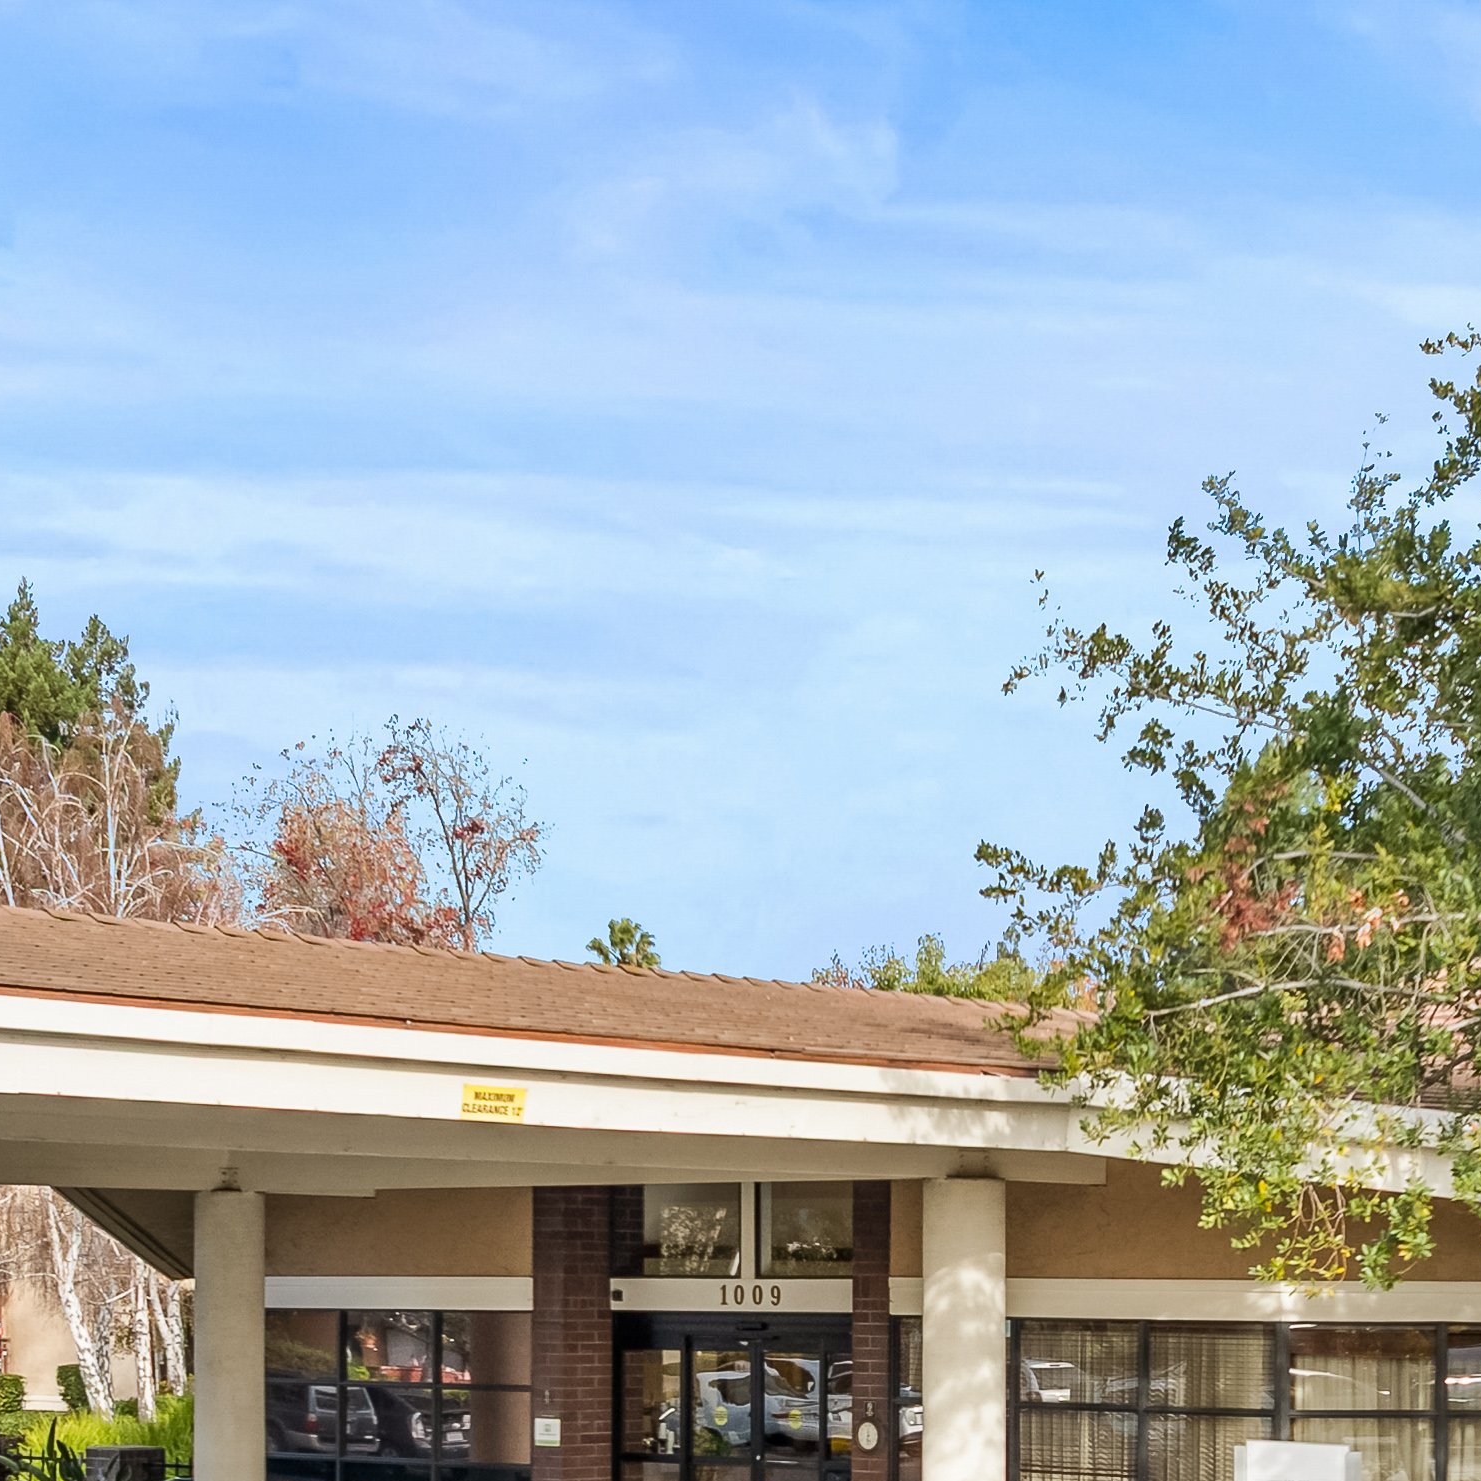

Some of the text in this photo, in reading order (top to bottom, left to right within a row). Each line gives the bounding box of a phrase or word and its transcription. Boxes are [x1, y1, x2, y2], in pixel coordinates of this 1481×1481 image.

[474, 1091, 516, 1103] MAXIMUM
[462, 1103, 509, 1116] CLEARANCE
[720, 1284, 781, 1306] 1009
